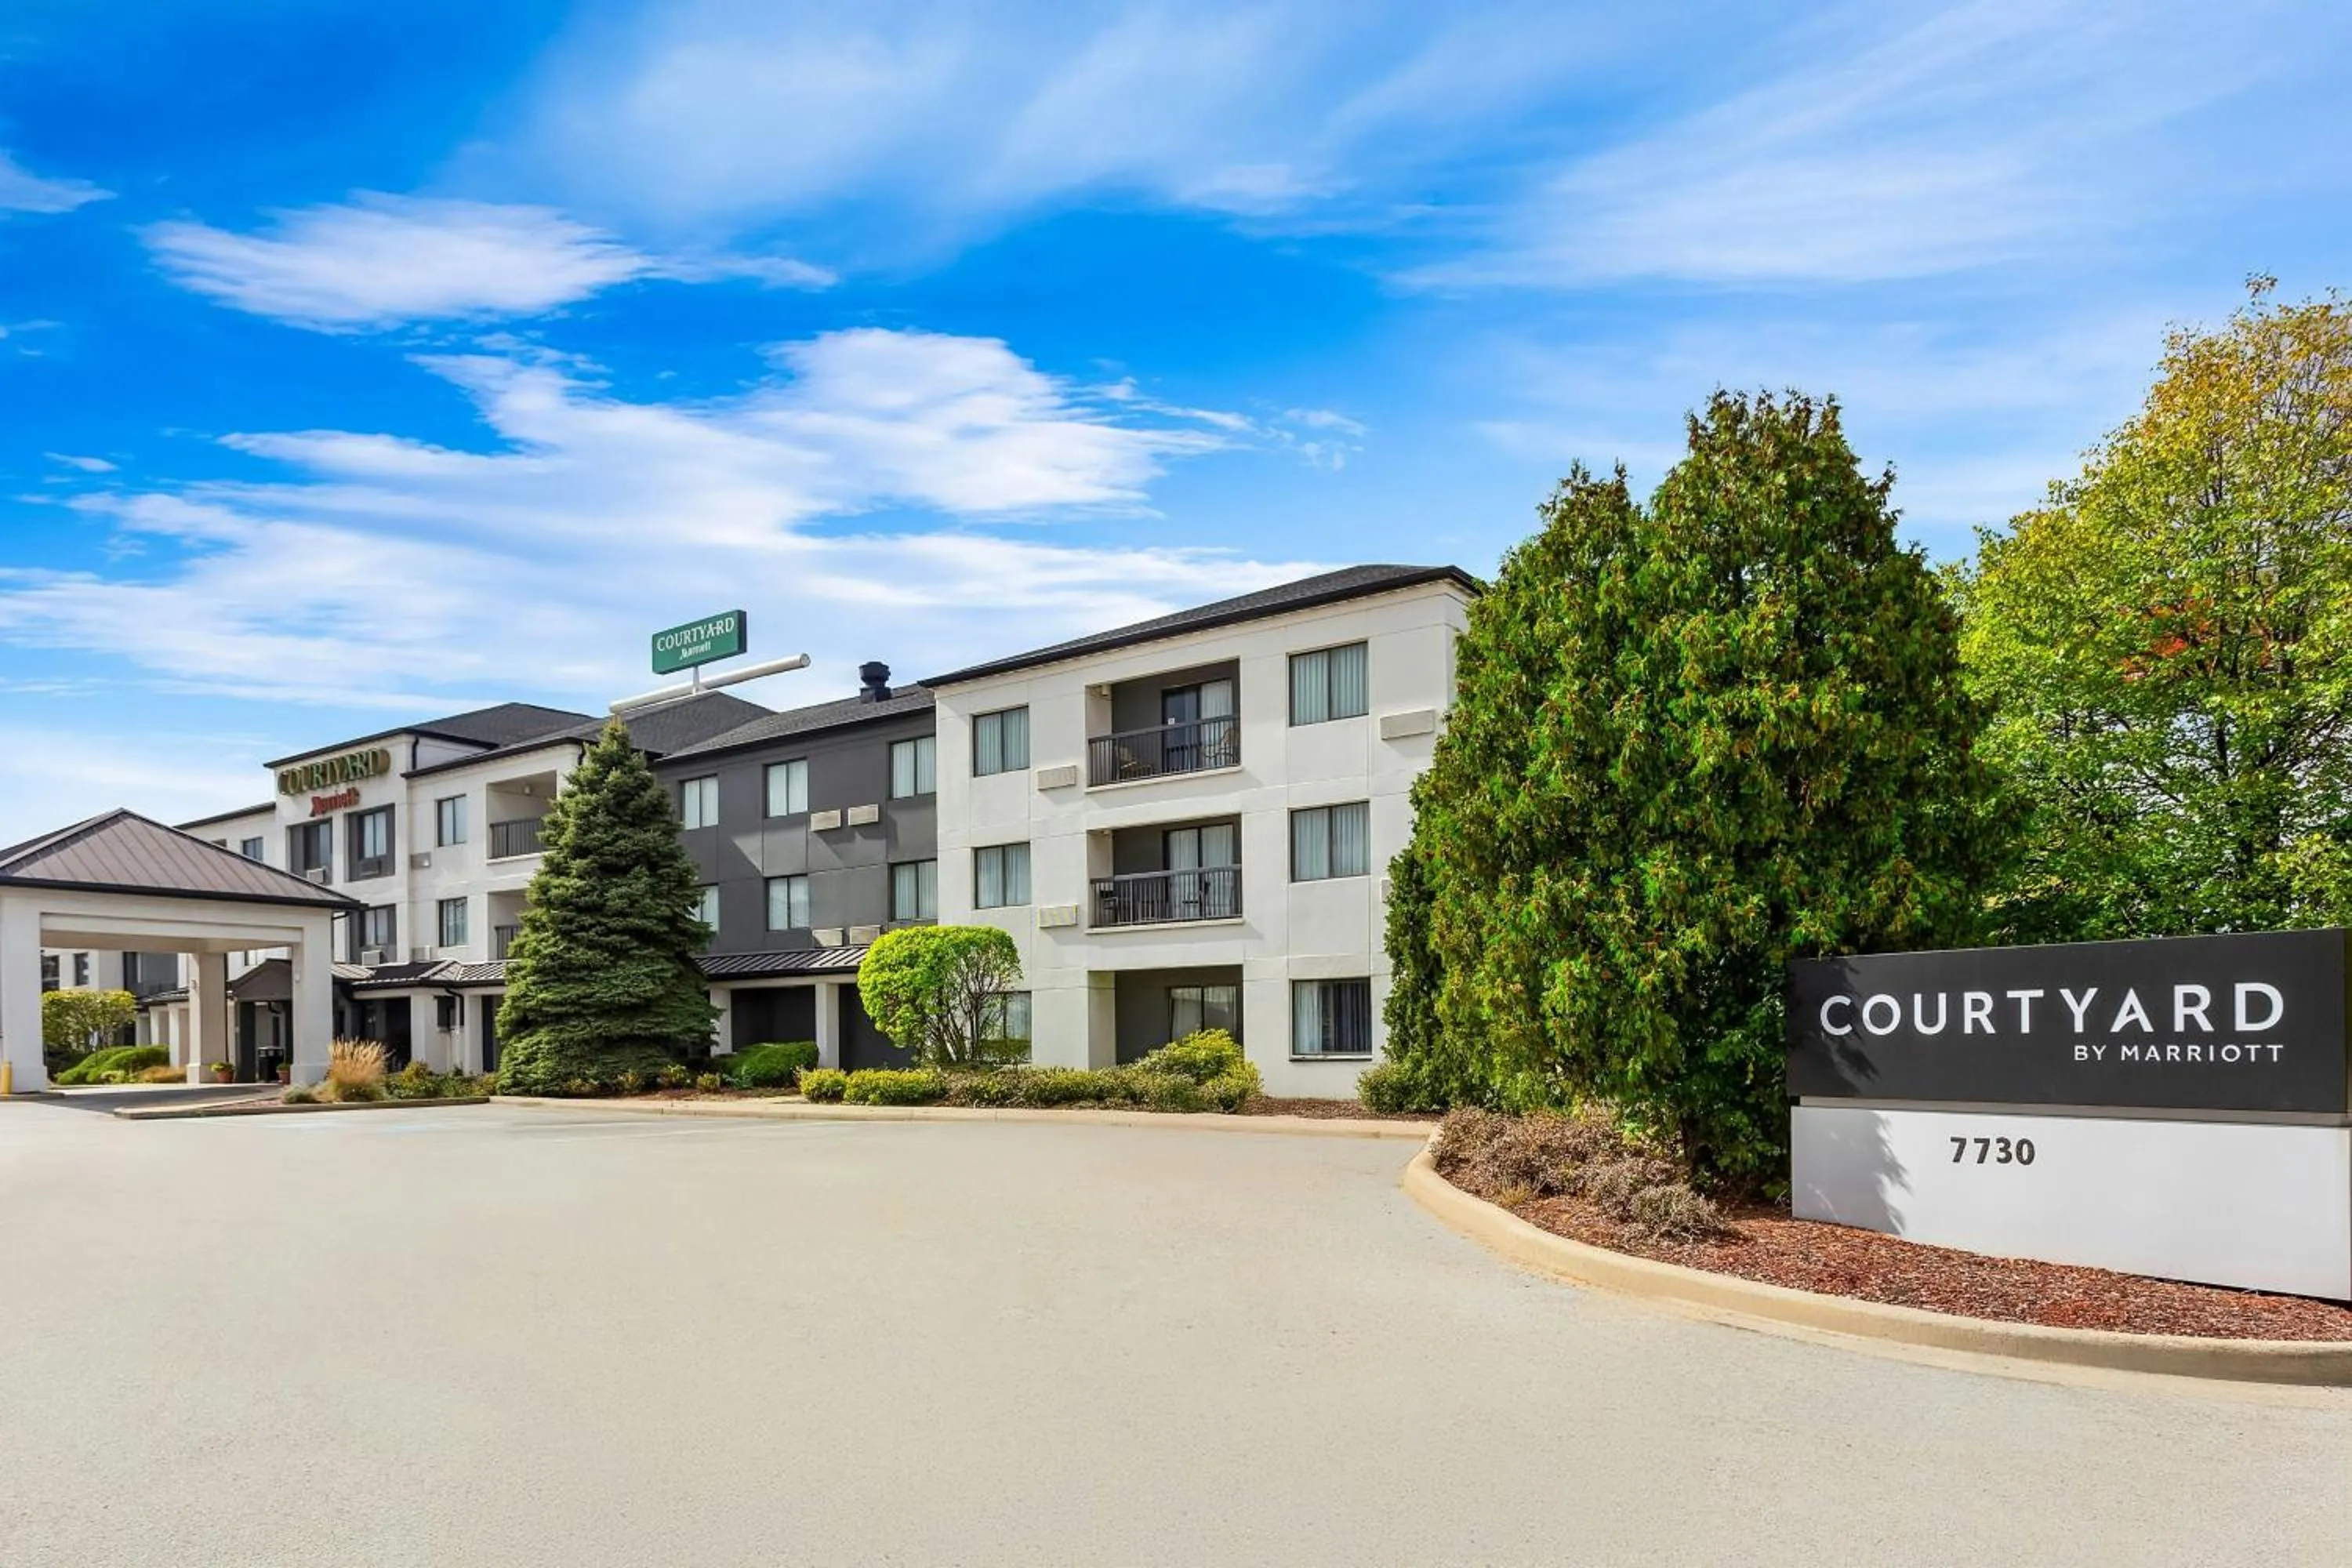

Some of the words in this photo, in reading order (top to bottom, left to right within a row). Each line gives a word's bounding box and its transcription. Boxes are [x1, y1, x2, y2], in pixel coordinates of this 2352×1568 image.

[657, 617, 735, 652] COURTYARD
[278, 748, 390, 795] COURTYARD
[1820, 982, 2284, 1036] COURTYARD
[2074, 1044, 2107, 1061] BY
[2121, 1044, 2284, 1062] MARRIOTT
[1950, 1137, 2036, 1166] 7730
